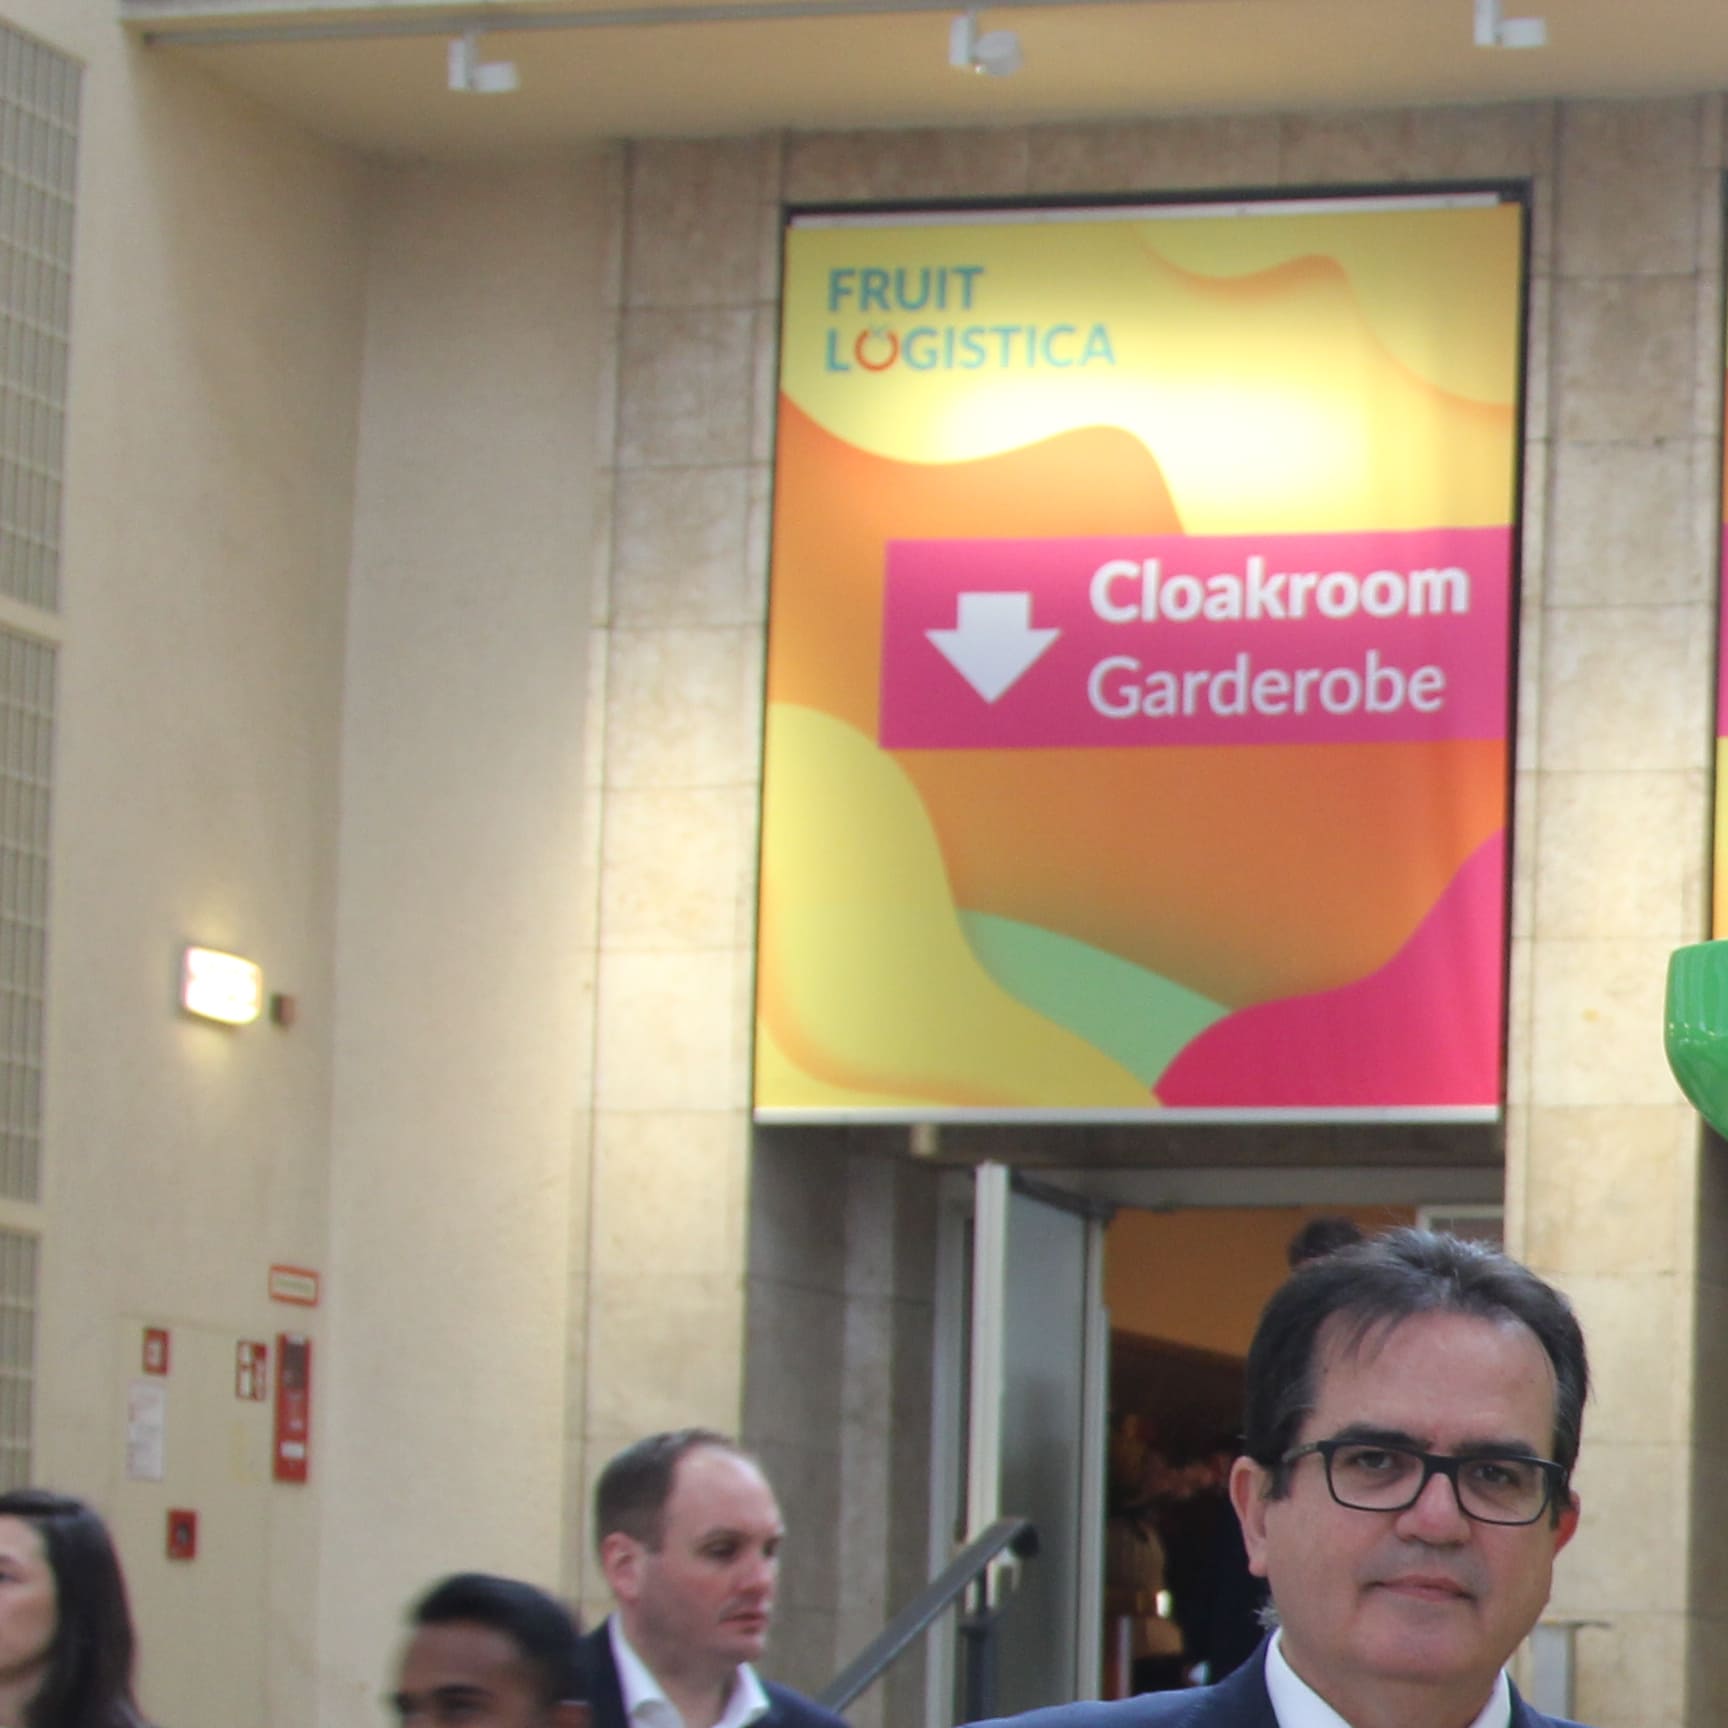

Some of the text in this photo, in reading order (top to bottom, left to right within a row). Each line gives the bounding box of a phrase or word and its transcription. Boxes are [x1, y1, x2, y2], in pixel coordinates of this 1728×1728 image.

[826, 266, 984, 311] FRUIT
[825, 322, 1117, 372] LOGISTICA
[1088, 556, 1471, 622] Cloakroom
[1086, 650, 1446, 719] Garderobe
